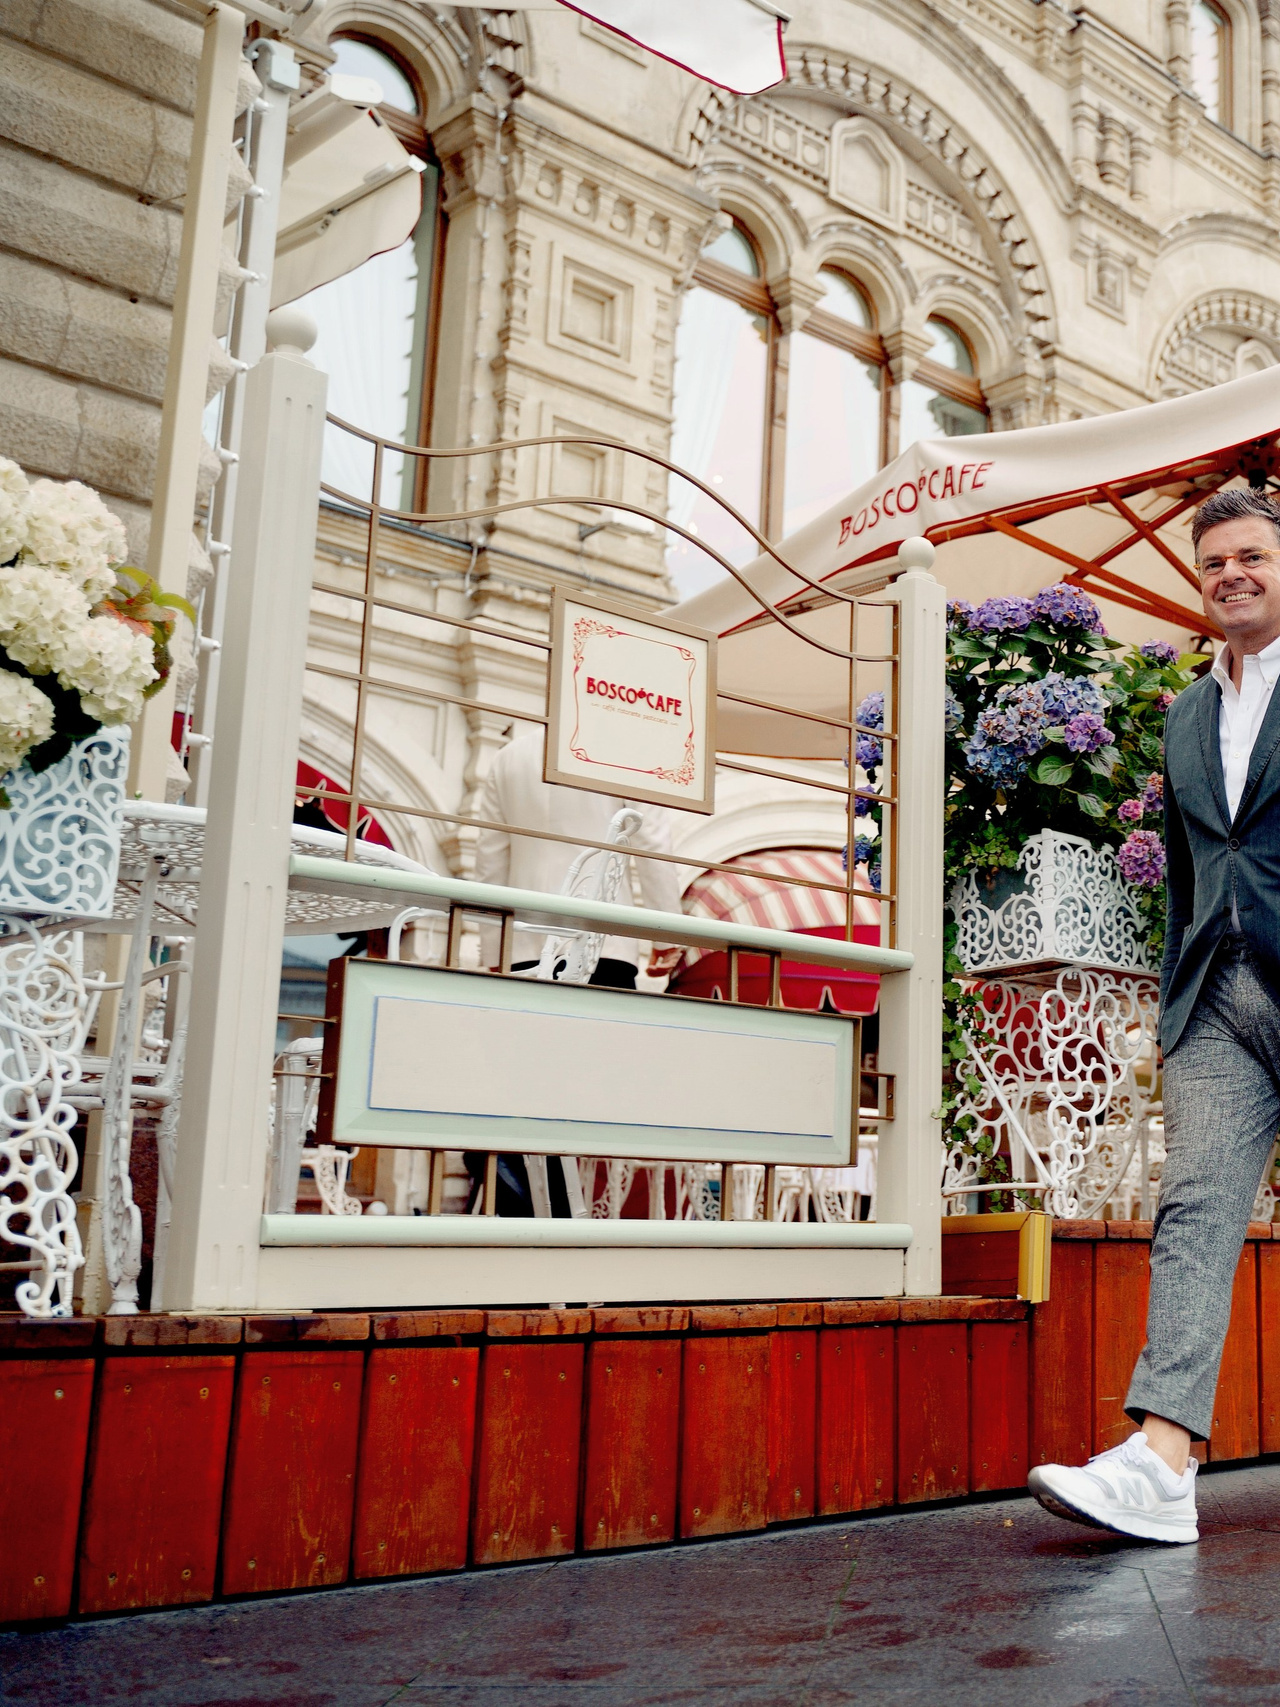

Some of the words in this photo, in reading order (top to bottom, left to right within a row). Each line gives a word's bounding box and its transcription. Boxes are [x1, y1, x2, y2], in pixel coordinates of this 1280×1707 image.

[838, 482, 920, 548] BOSCO
[928, 461, 996, 500] CAFE
[586, 676, 638, 705] BOSCO
[646, 692, 683, 716] CAFE
[1118, 1477, 1144, 1506] N
